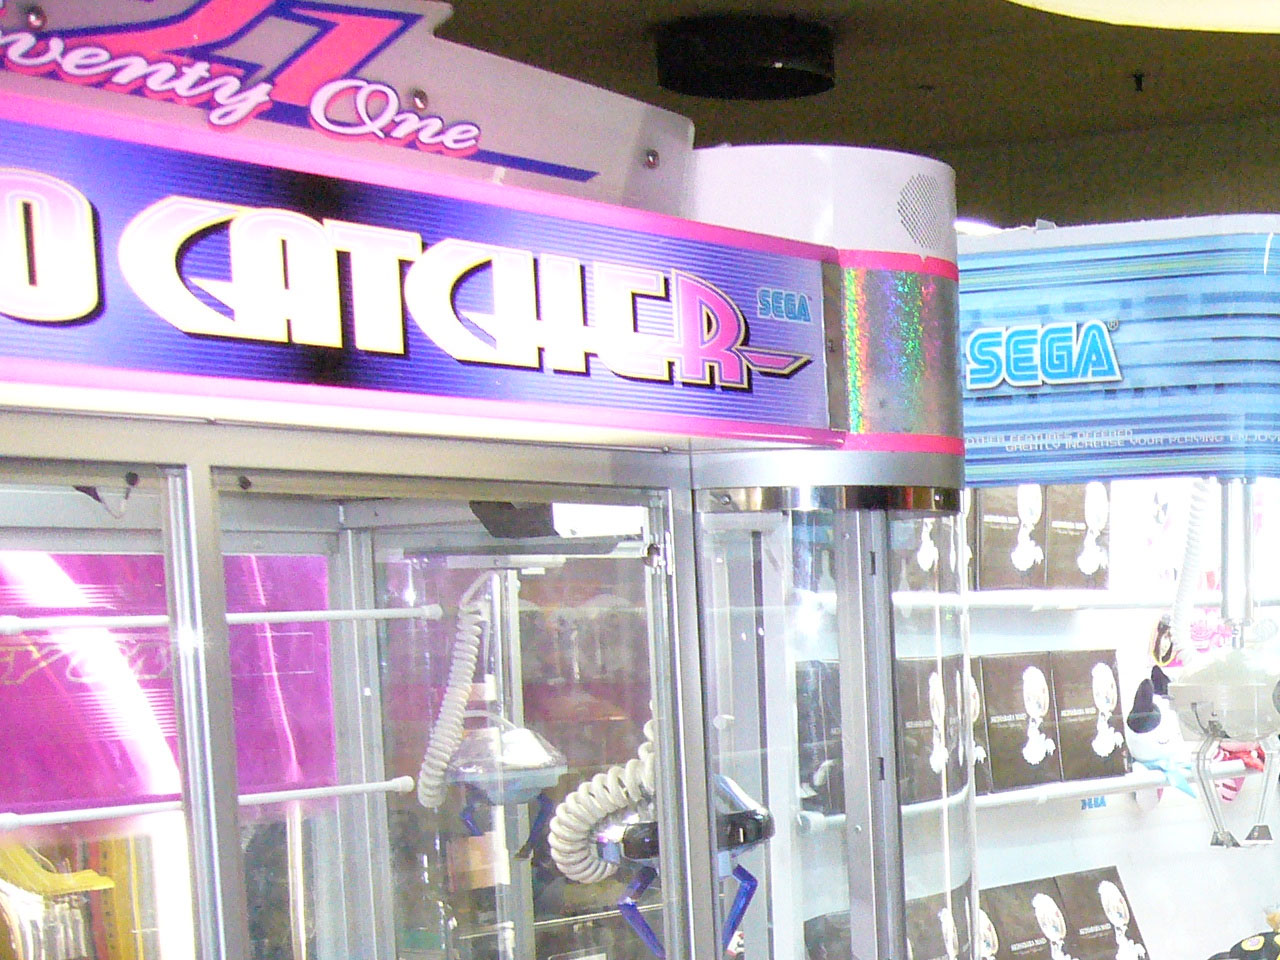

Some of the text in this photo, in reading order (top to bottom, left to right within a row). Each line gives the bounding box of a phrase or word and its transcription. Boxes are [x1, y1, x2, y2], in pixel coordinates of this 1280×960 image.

[308, 78, 482, 150] One
[118, 195, 755, 392] CATCHER
[757, 287, 812, 324] SEGA
[966, 319, 1123, 390] SEGA
